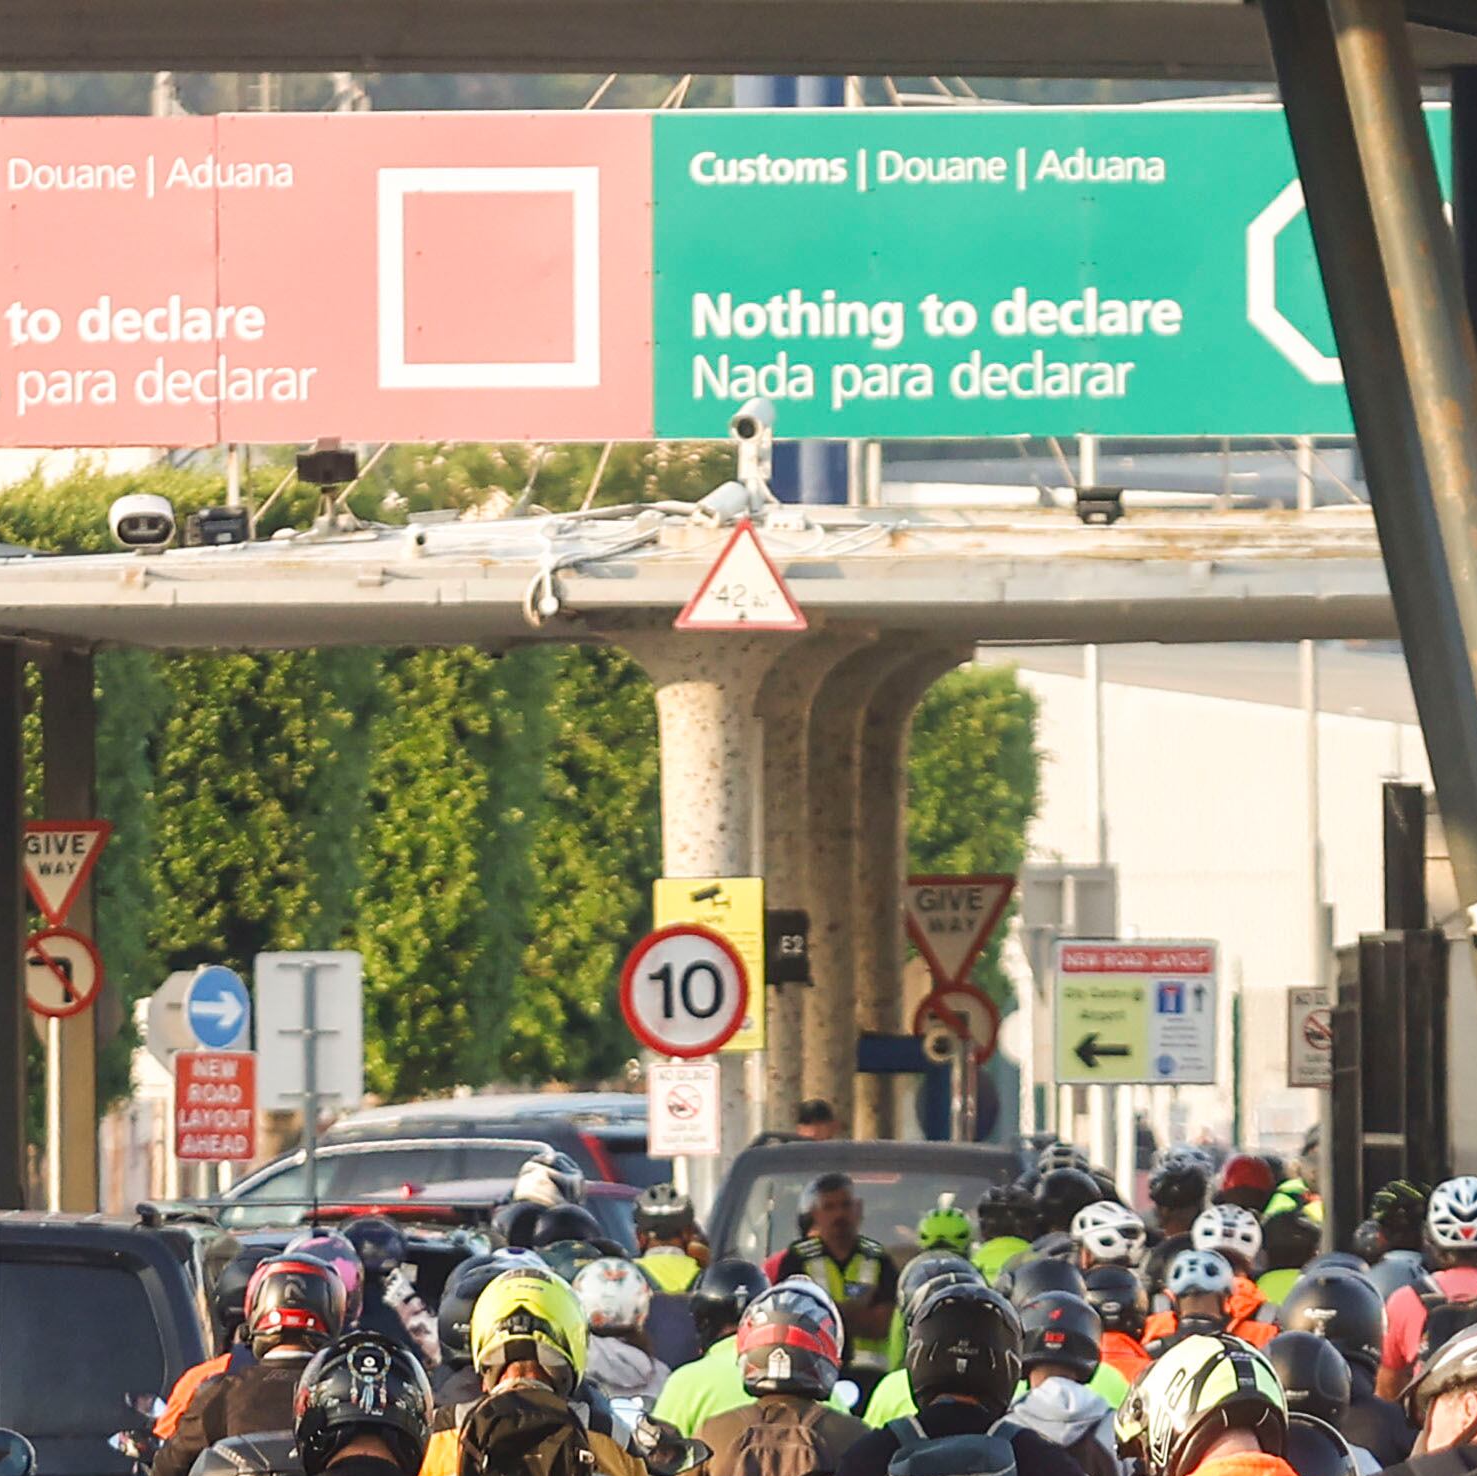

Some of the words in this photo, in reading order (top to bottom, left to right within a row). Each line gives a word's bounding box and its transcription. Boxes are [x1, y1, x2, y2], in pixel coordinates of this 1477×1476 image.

[8, 158, 135, 191] Douane
[165, 155, 293, 189] Aduana
[690, 152, 847, 186] Customs
[878, 150, 1007, 184] Douane
[1036, 147, 1165, 183] Aduana
[5, 301, 61, 346] to
[77, 294, 266, 343] declare
[693, 288, 904, 349] Nothing
[919, 293, 977, 337] to
[992, 286, 1182, 337] declare
[17, 370, 117, 416] para
[134, 354, 318, 405] declarar
[693, 352, 814, 400] Nada
[832, 364, 933, 411] para
[950, 350, 1135, 400] declarar
[24, 834, 86, 855] GIVE
[38, 862, 77, 875] WAY
[915, 887, 985, 912] GIVE
[928, 917, 976, 934] WAY
[1065, 952, 1100, 967] NEW
[1104, 952, 1149, 967] ROAD
[1152, 952, 1209, 967] LAYOUT
[648, 959, 724, 1018] 10
[192, 1059, 238, 1078] NEW
[187, 1083, 243, 1102] ROAD
[178, 1108, 252, 1128] LAYOUT
[182, 1134, 249, 1153] AHEAD
